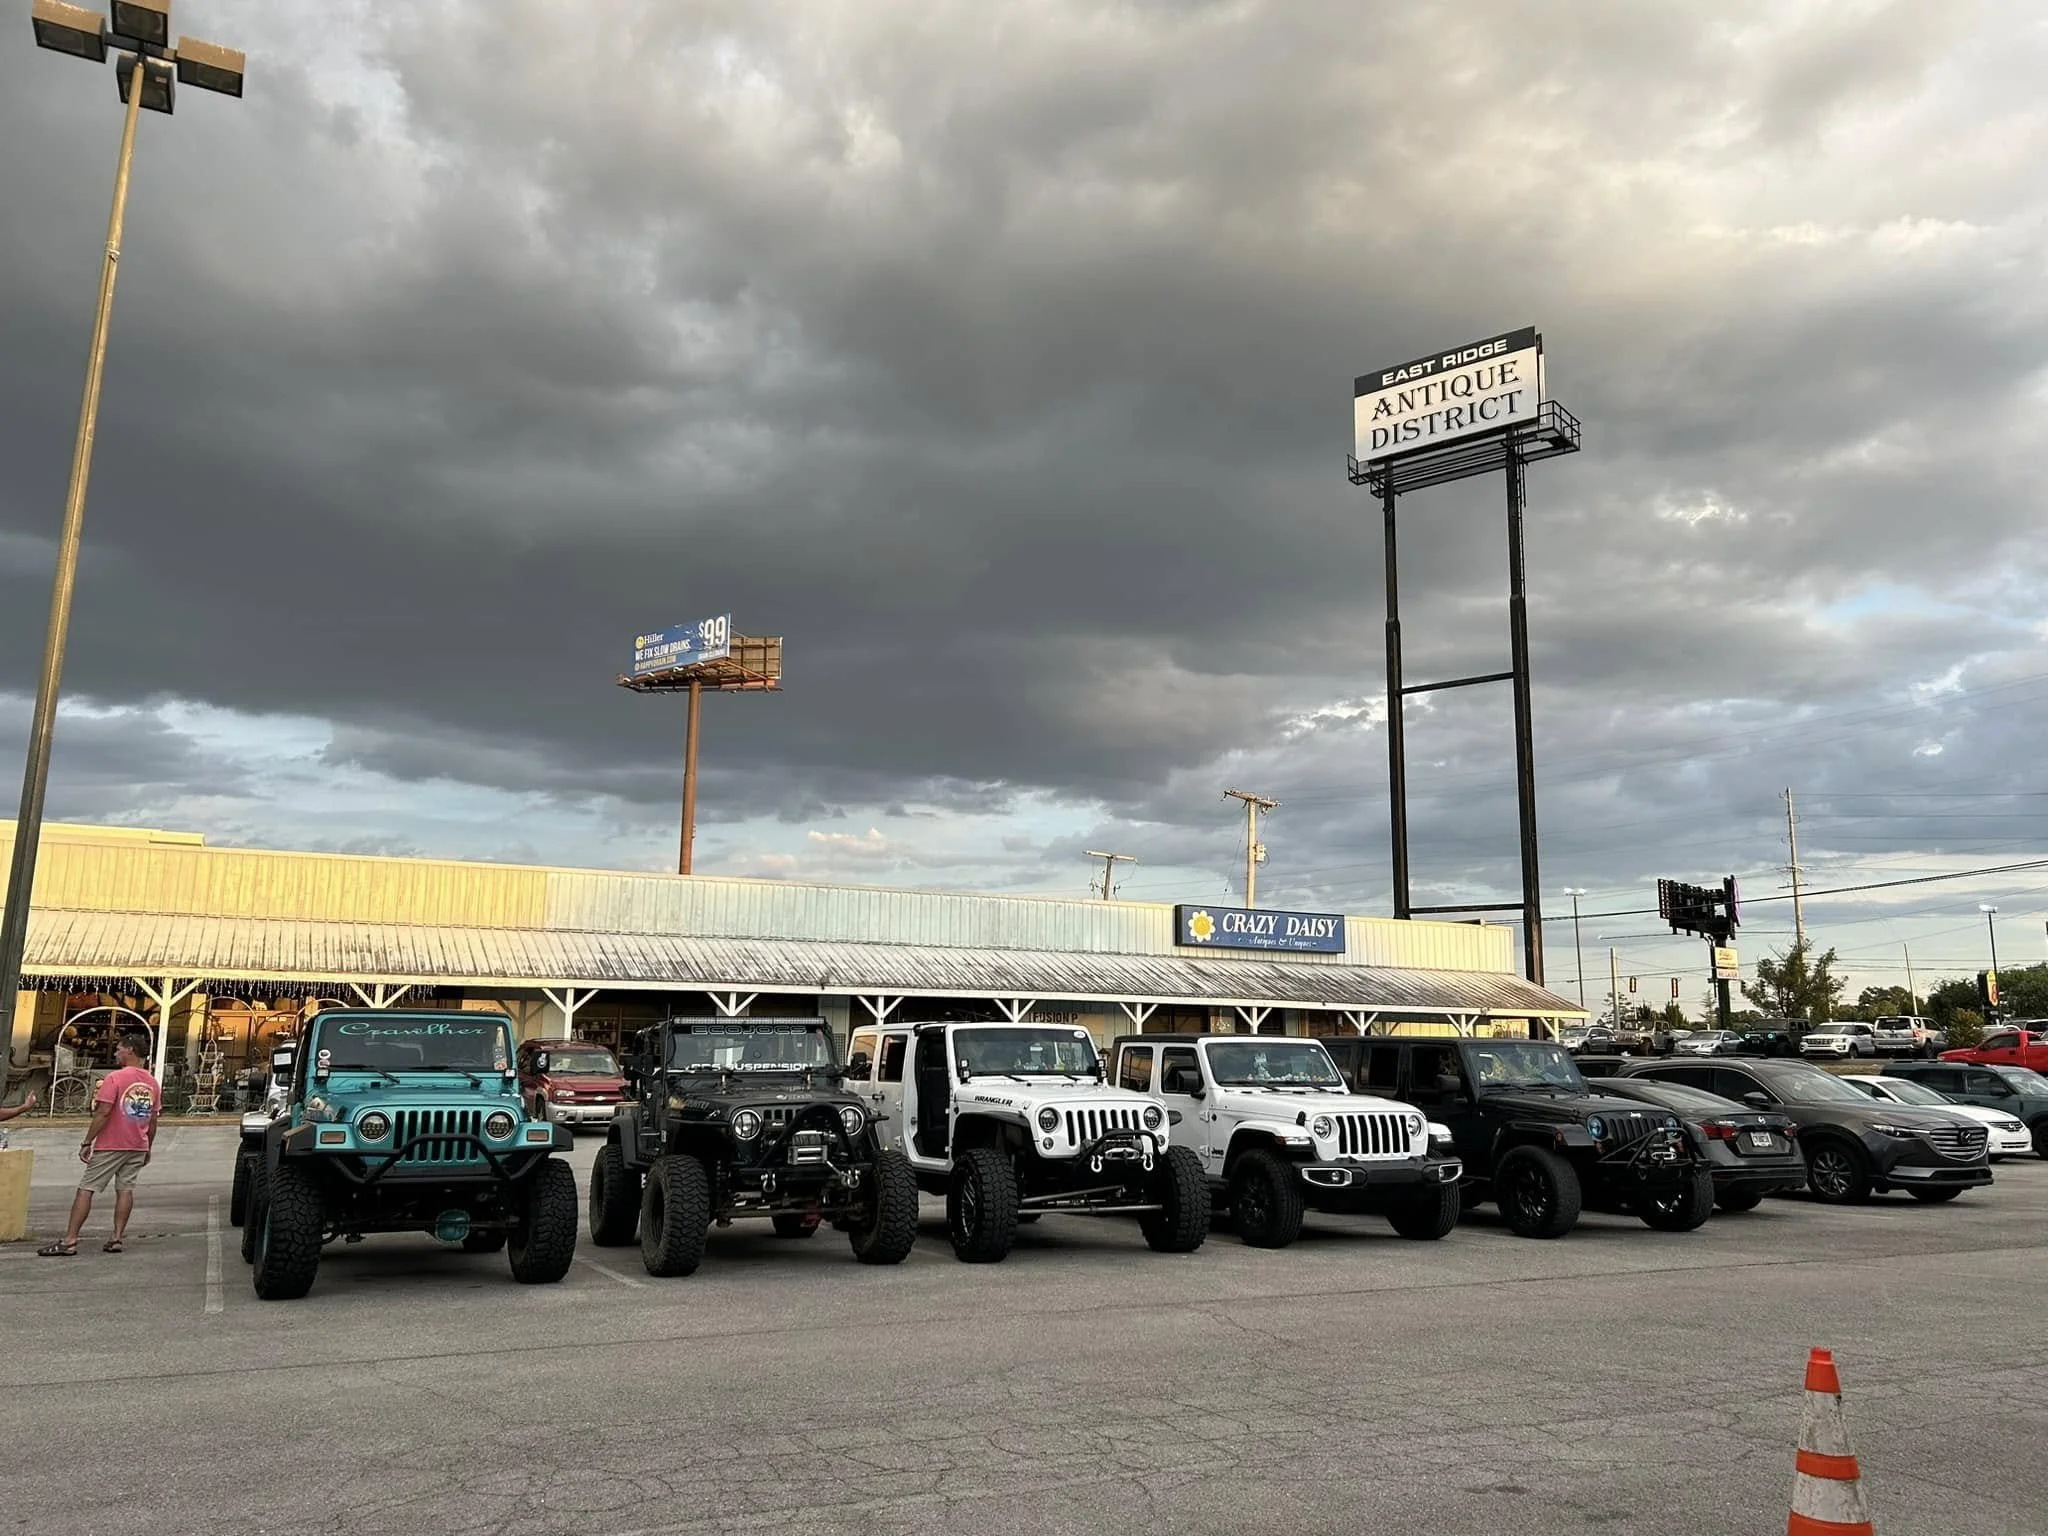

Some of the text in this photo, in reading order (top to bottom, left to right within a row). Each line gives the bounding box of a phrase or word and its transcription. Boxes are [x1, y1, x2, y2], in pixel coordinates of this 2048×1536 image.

[1382, 338, 1508, 386] EAST RIDGE
[1371, 359, 1520, 422] ANTIQUE
[1371, 389, 1523, 451] DISTRICT
[644, 632, 664, 645] Hiller
[699, 616, 726, 646] $99
[1222, 912, 1339, 938] CRAZY DAISY
[974, 1095, 1013, 1107] WRANGLER
